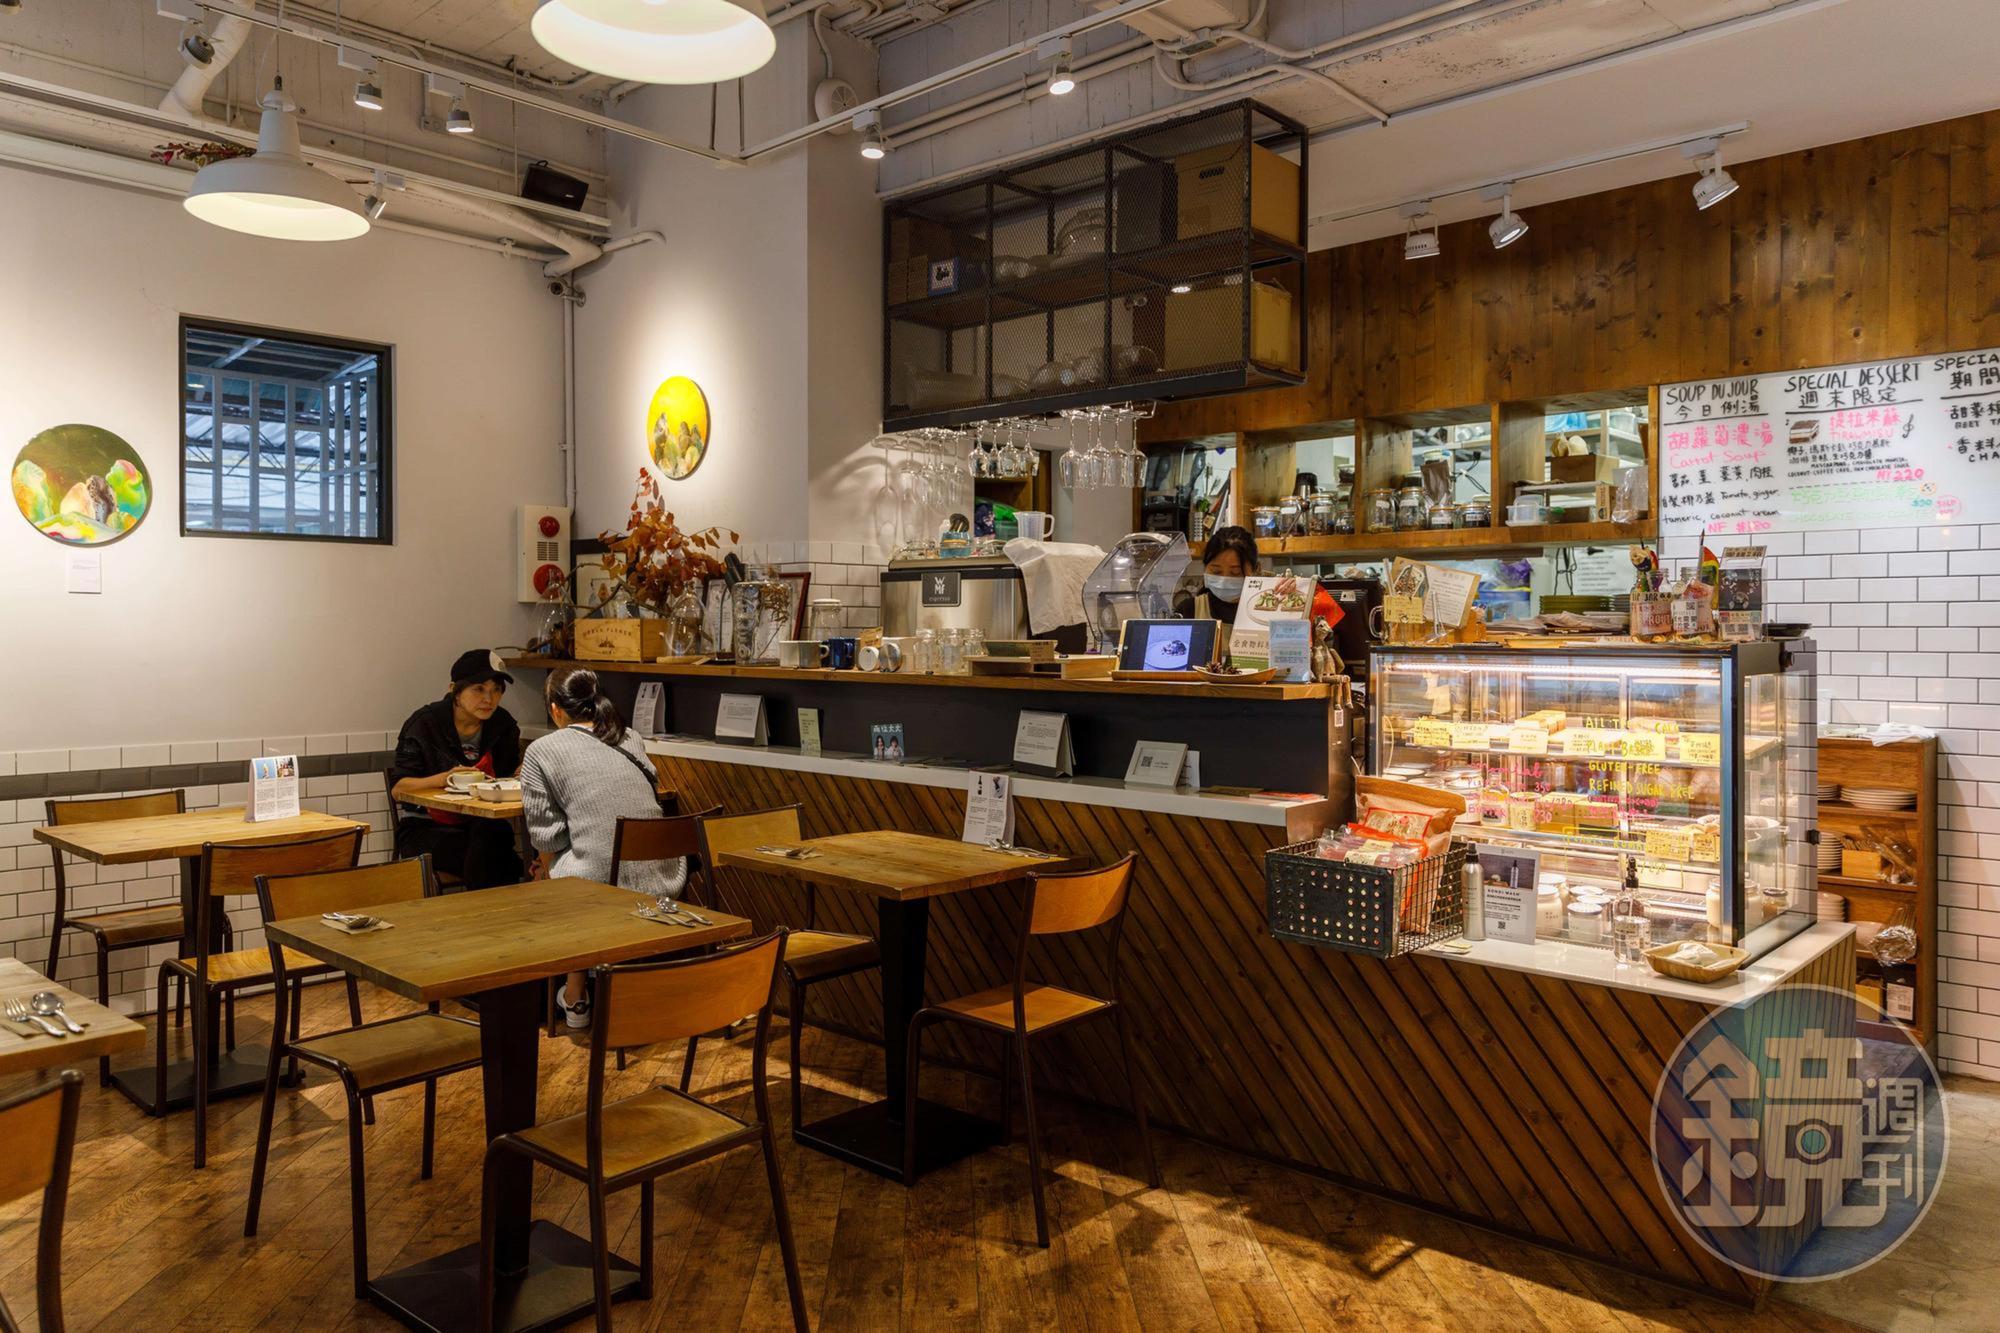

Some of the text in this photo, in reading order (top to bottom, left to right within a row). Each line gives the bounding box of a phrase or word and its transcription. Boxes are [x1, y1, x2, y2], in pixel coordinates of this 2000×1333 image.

[1784, 363, 1921, 392] SPECIAL DESSERT
[1665, 379, 1759, 405] SOUP DU JOUR
[1798, 386, 1897, 409] 週末限定
[1675, 394, 1760, 420] 今日例湯
[1828, 405, 1900, 430] 提拉米蘇
[1664, 421, 1774, 449] 胡蘿蔔濃湯
[1670, 449, 1767, 469] Carrot Soup
[1893, 468, 1924, 481] 220
[1710, 508, 1750, 520] coconut
